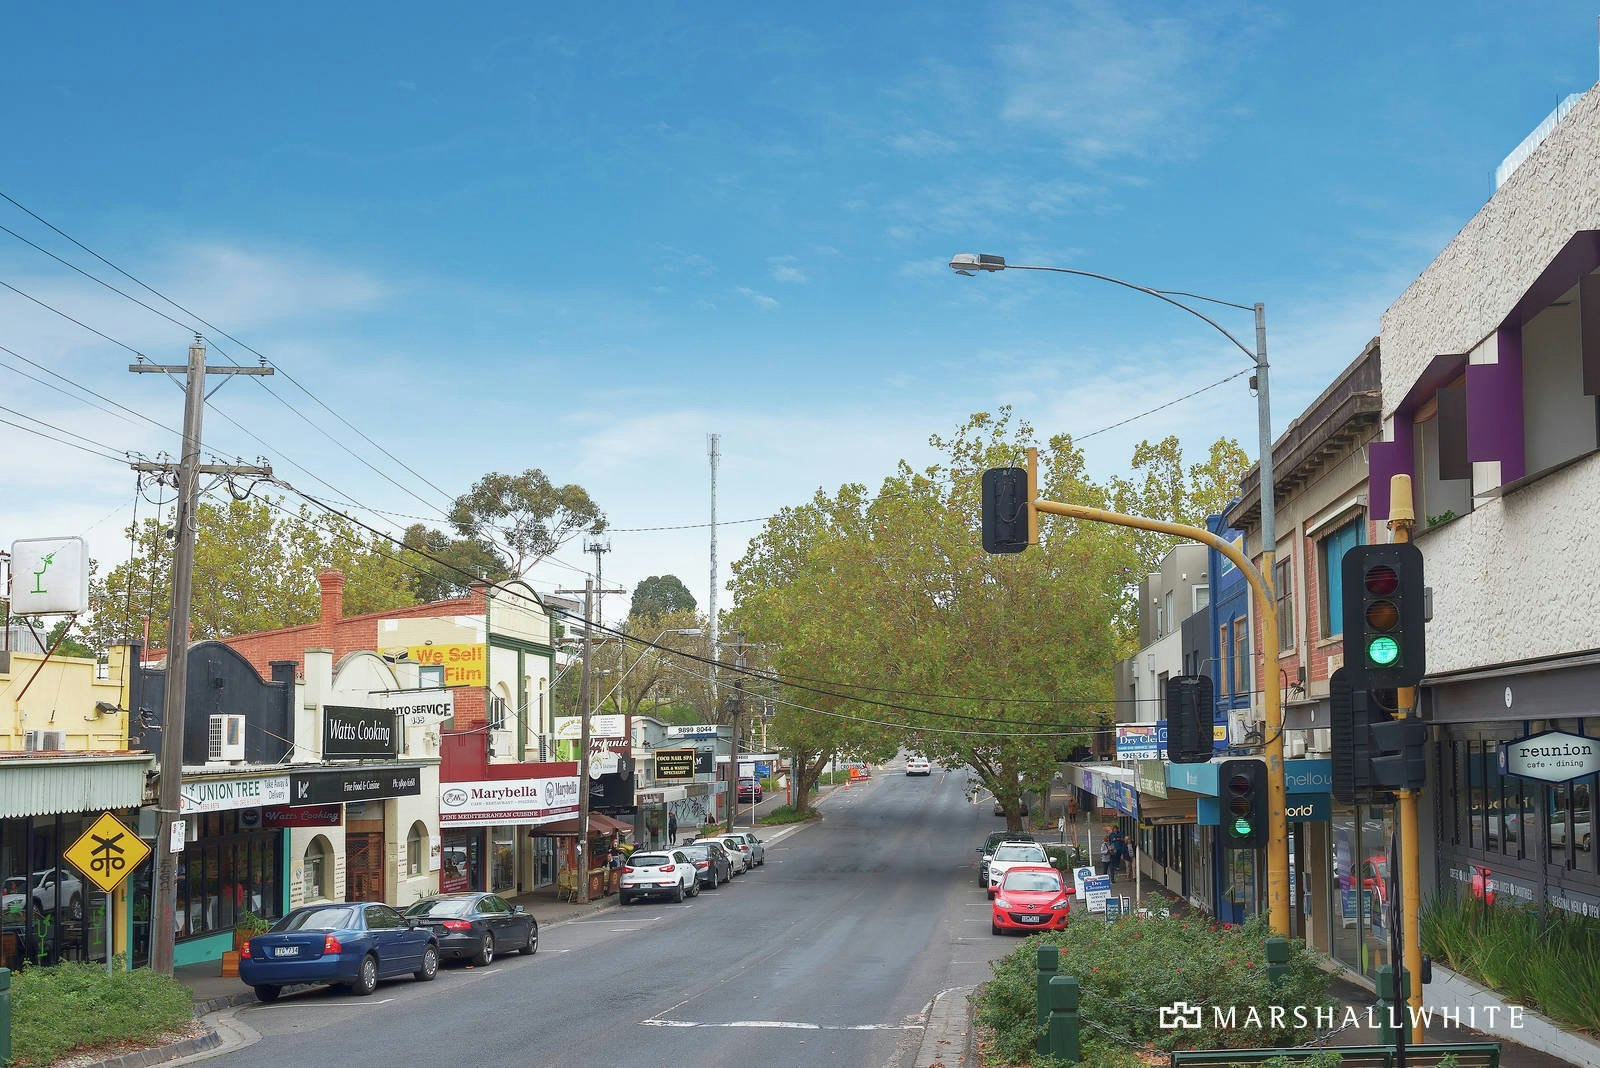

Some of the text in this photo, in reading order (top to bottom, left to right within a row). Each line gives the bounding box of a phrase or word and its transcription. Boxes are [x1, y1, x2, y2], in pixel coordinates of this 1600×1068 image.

[416, 647, 482, 664] We Sell
[445, 667, 481, 681] Film
[387, 703, 452, 716] UTO SERVICE
[329, 718, 391, 747] Watts Cooking
[1120, 735, 1137, 745] Dry
[1140, 734, 1157, 743] Cle
[1122, 751, 1149, 759] 9836
[1519, 743, 1593, 758] reunion
[1556, 760, 1584, 768] dining
[199, 780, 260, 801] UNION TREE
[264, 780, 273, 789] Take
[274, 779, 284, 790] Away
[344, 781, 352, 791] Fine
[353, 780, 362, 791] Food
[367, 780, 380, 790] Cuisine
[555, 780, 577, 798] Marybella
[268, 790, 285, 800] Delivery
[471, 786, 537, 800] Marybella
[457, 812, 512, 820] MEDITERRANEAN
[1285, 804, 1313, 817] orld
